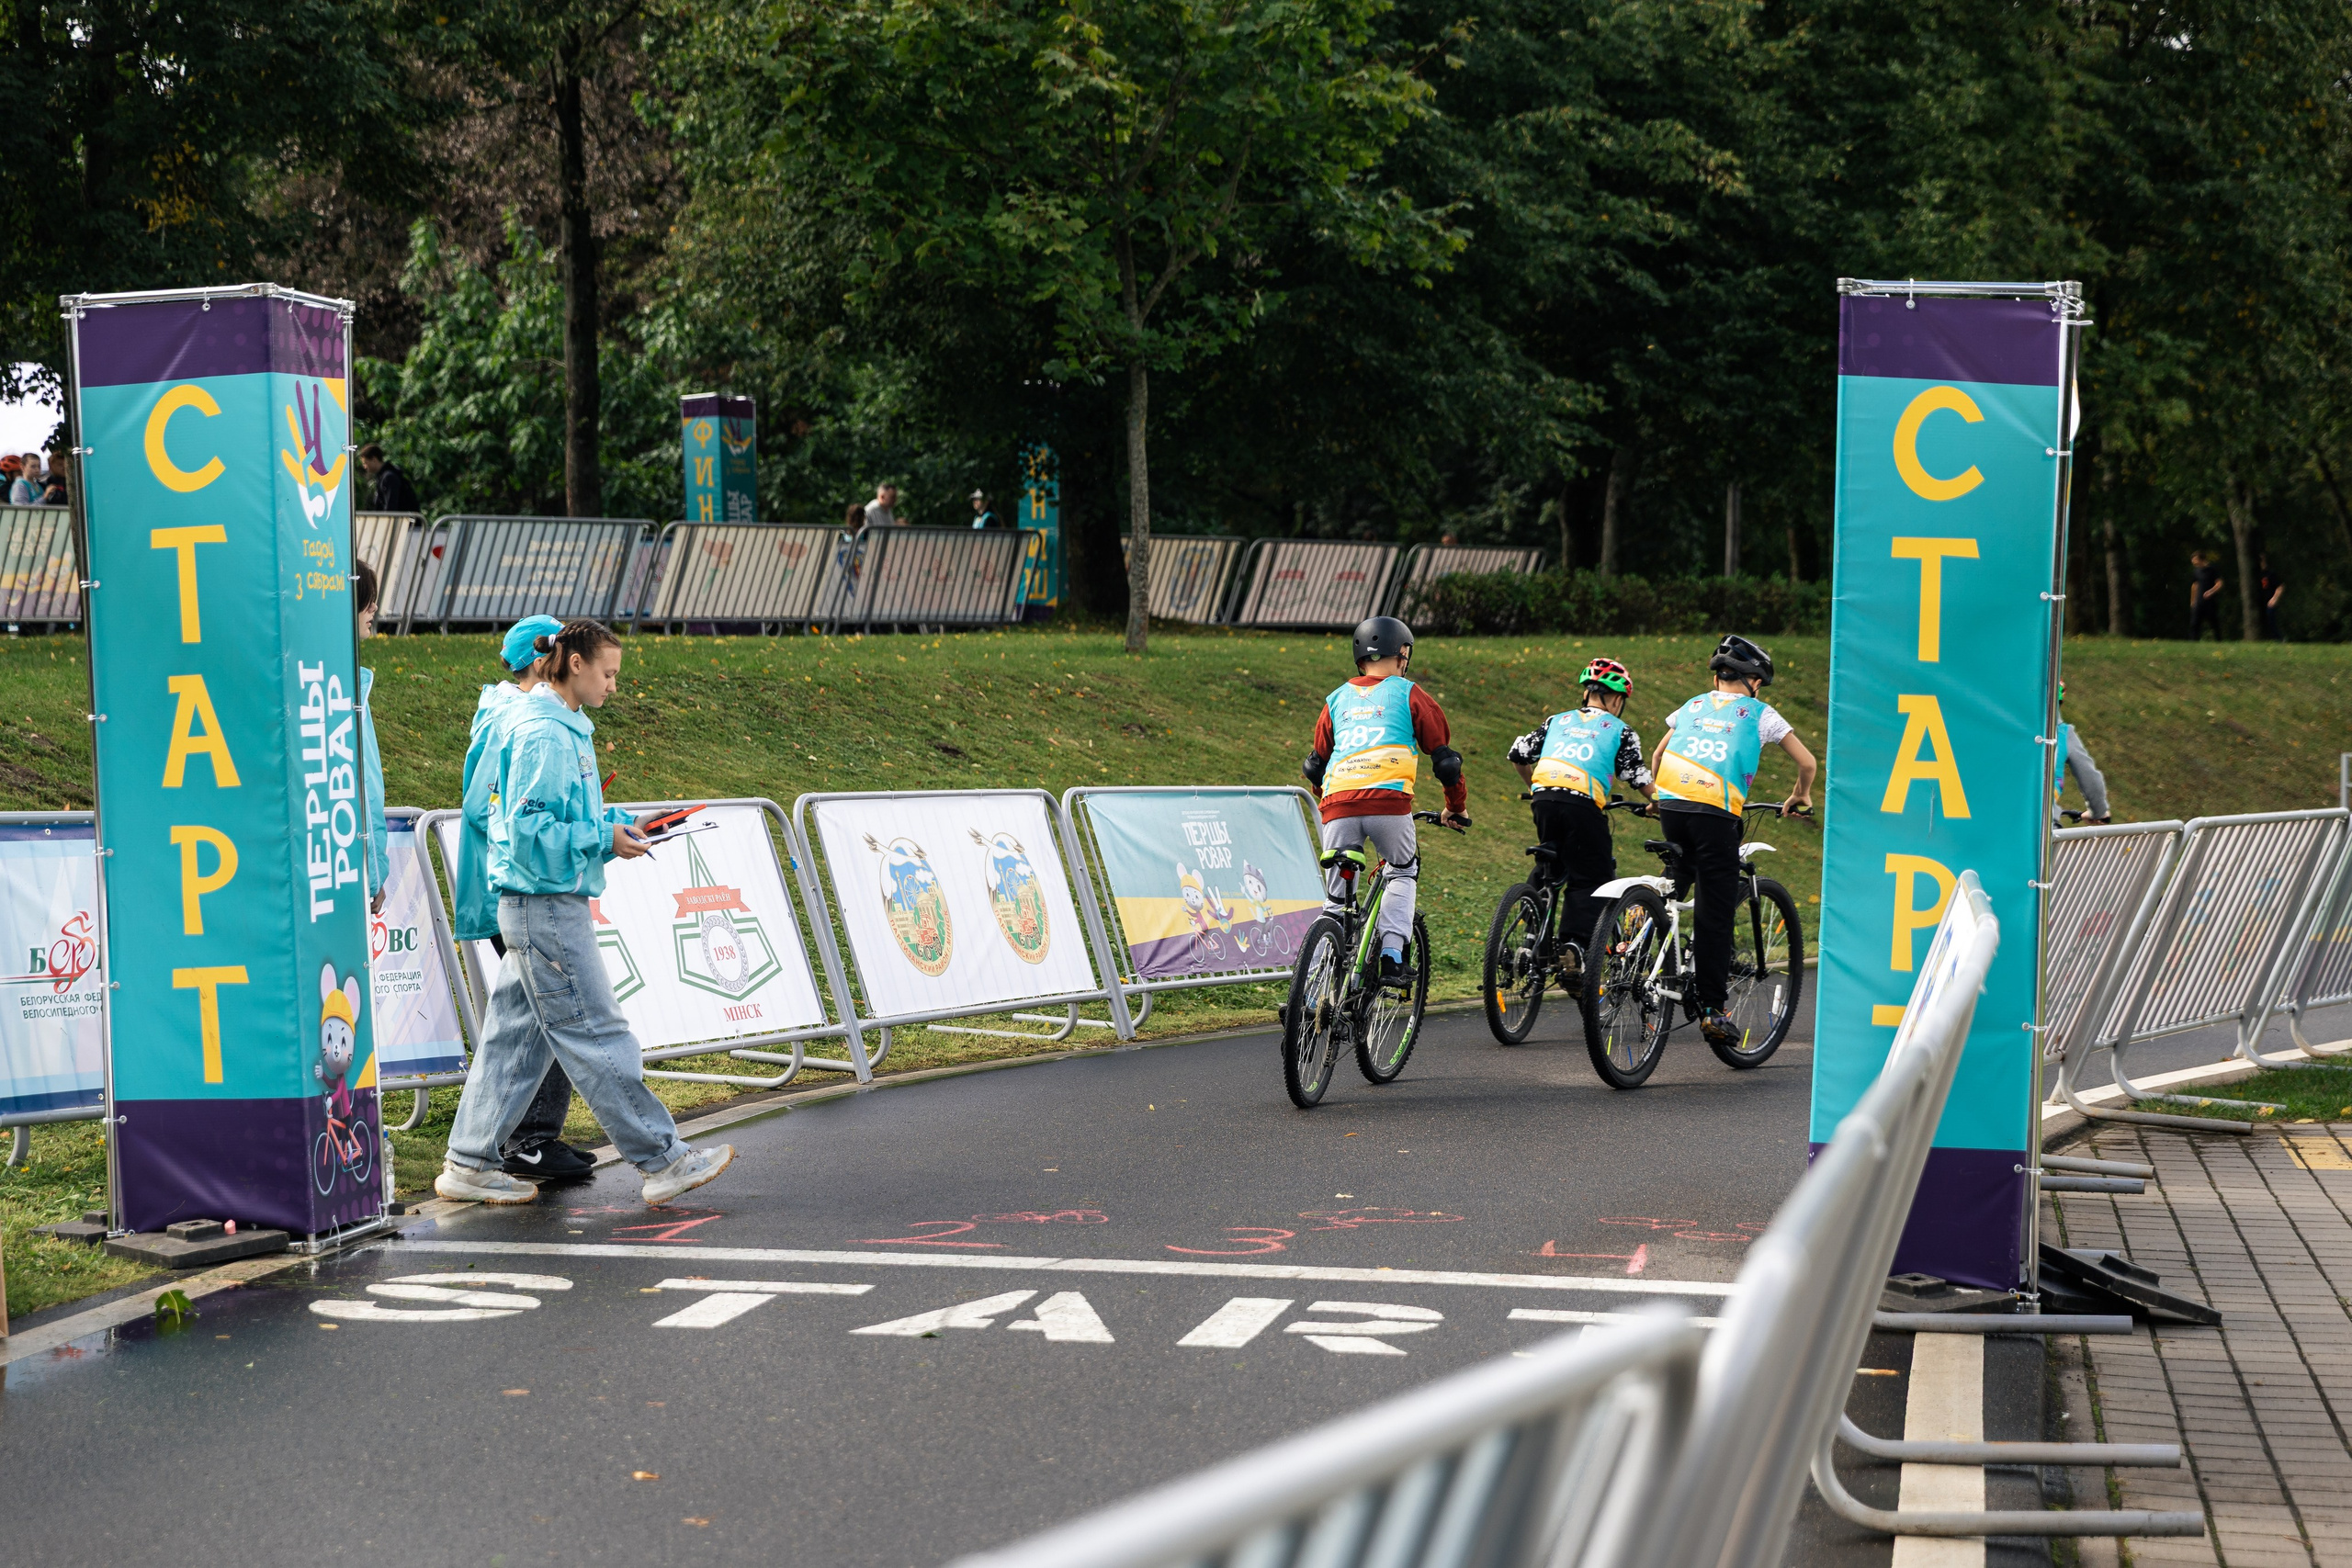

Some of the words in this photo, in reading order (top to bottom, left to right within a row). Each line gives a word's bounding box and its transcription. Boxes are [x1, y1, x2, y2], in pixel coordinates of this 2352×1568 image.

[693, 420, 715, 523] ФИН
[307, 570, 345, 600] сябрамі
[1871, 385, 1984, 1027] СТАР
[144, 384, 249, 1084] СТАРТ
[1339, 725, 1385, 752] 287
[1551, 741, 1594, 761] 260
[1682, 736, 1728, 762] 393
[299, 660, 334, 923] ПЕРШЫ
[327, 674, 359, 889] РОВАР
[1182, 820, 1232, 846] ПЕРШЫ
[1195, 846, 1232, 870] РОВАР
[713, 945, 736, 962] 1938
[379, 971, 423, 982] ФЕДЕРАЦИЯ
[393, 983, 422, 993] СПОРТА
[20, 993, 81, 1007] БЕЛОРУССКАЯ
[23, 1005, 96, 1020] ВЕЛОСИПЕДНОГО
[723, 1003, 763, 1022] МІНСК
[844, 1221, 1011, 1248] 2
[1163, 1227, 1296, 1256] 3
